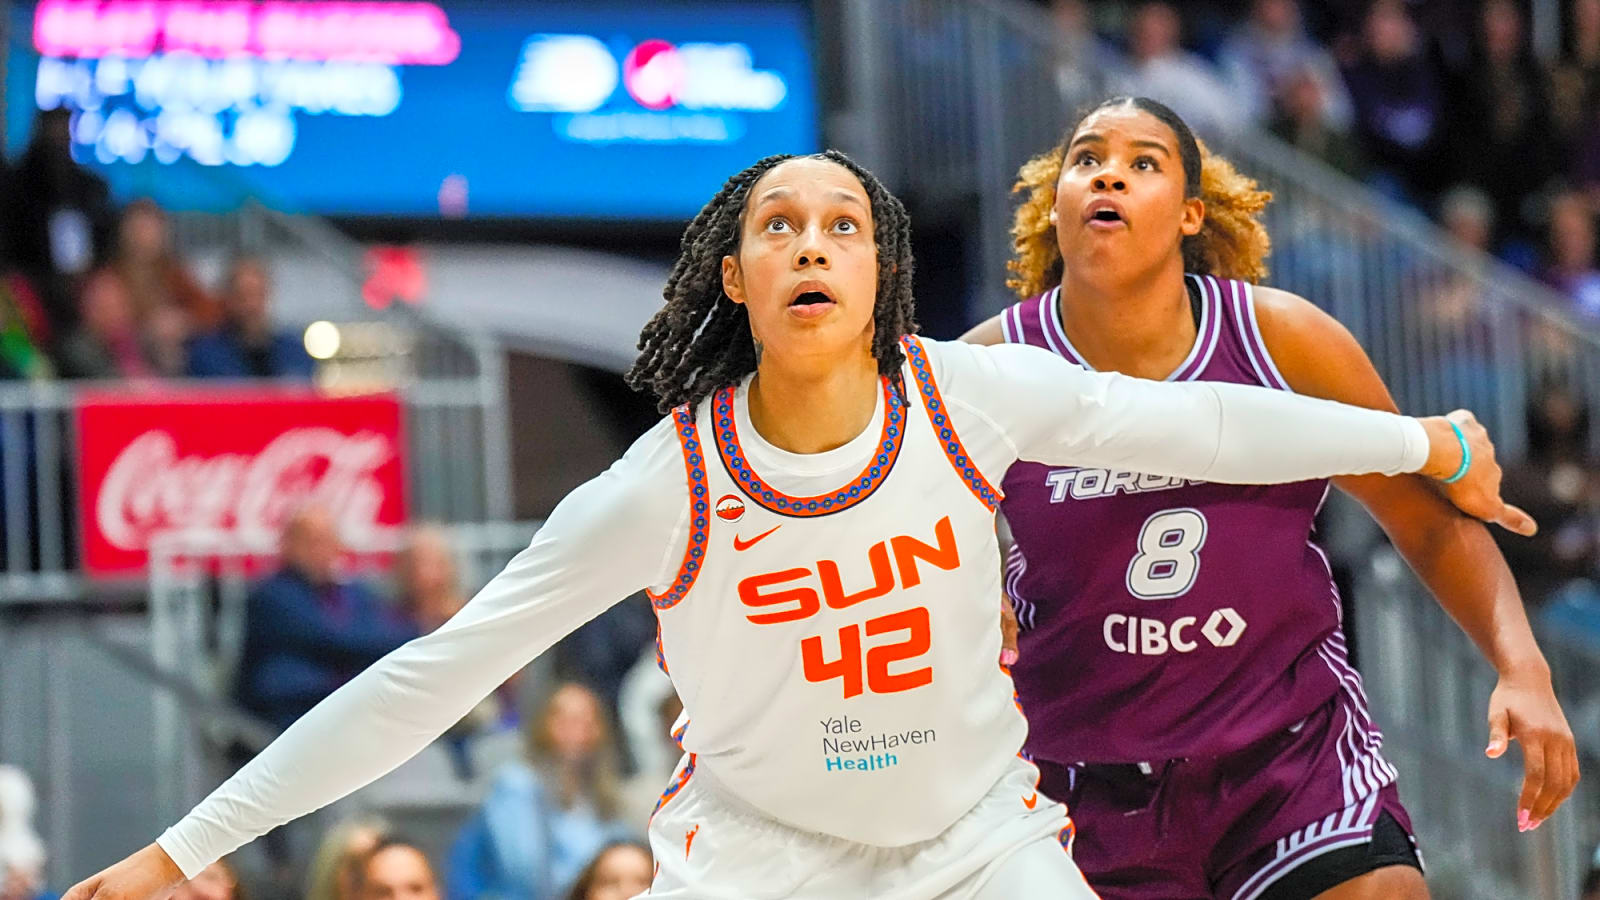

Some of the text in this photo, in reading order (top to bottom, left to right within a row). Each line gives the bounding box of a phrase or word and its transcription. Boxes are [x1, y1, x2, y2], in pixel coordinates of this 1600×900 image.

[738, 516, 961, 625] SUN
[1126, 507, 1208, 600] 8
[800, 606, 933, 700] 42
[1103, 613, 1198, 655] CIBC
[820, 715, 862, 734] Yale
[822, 727, 936, 756] NewHaven
[826, 752, 898, 772] Health
